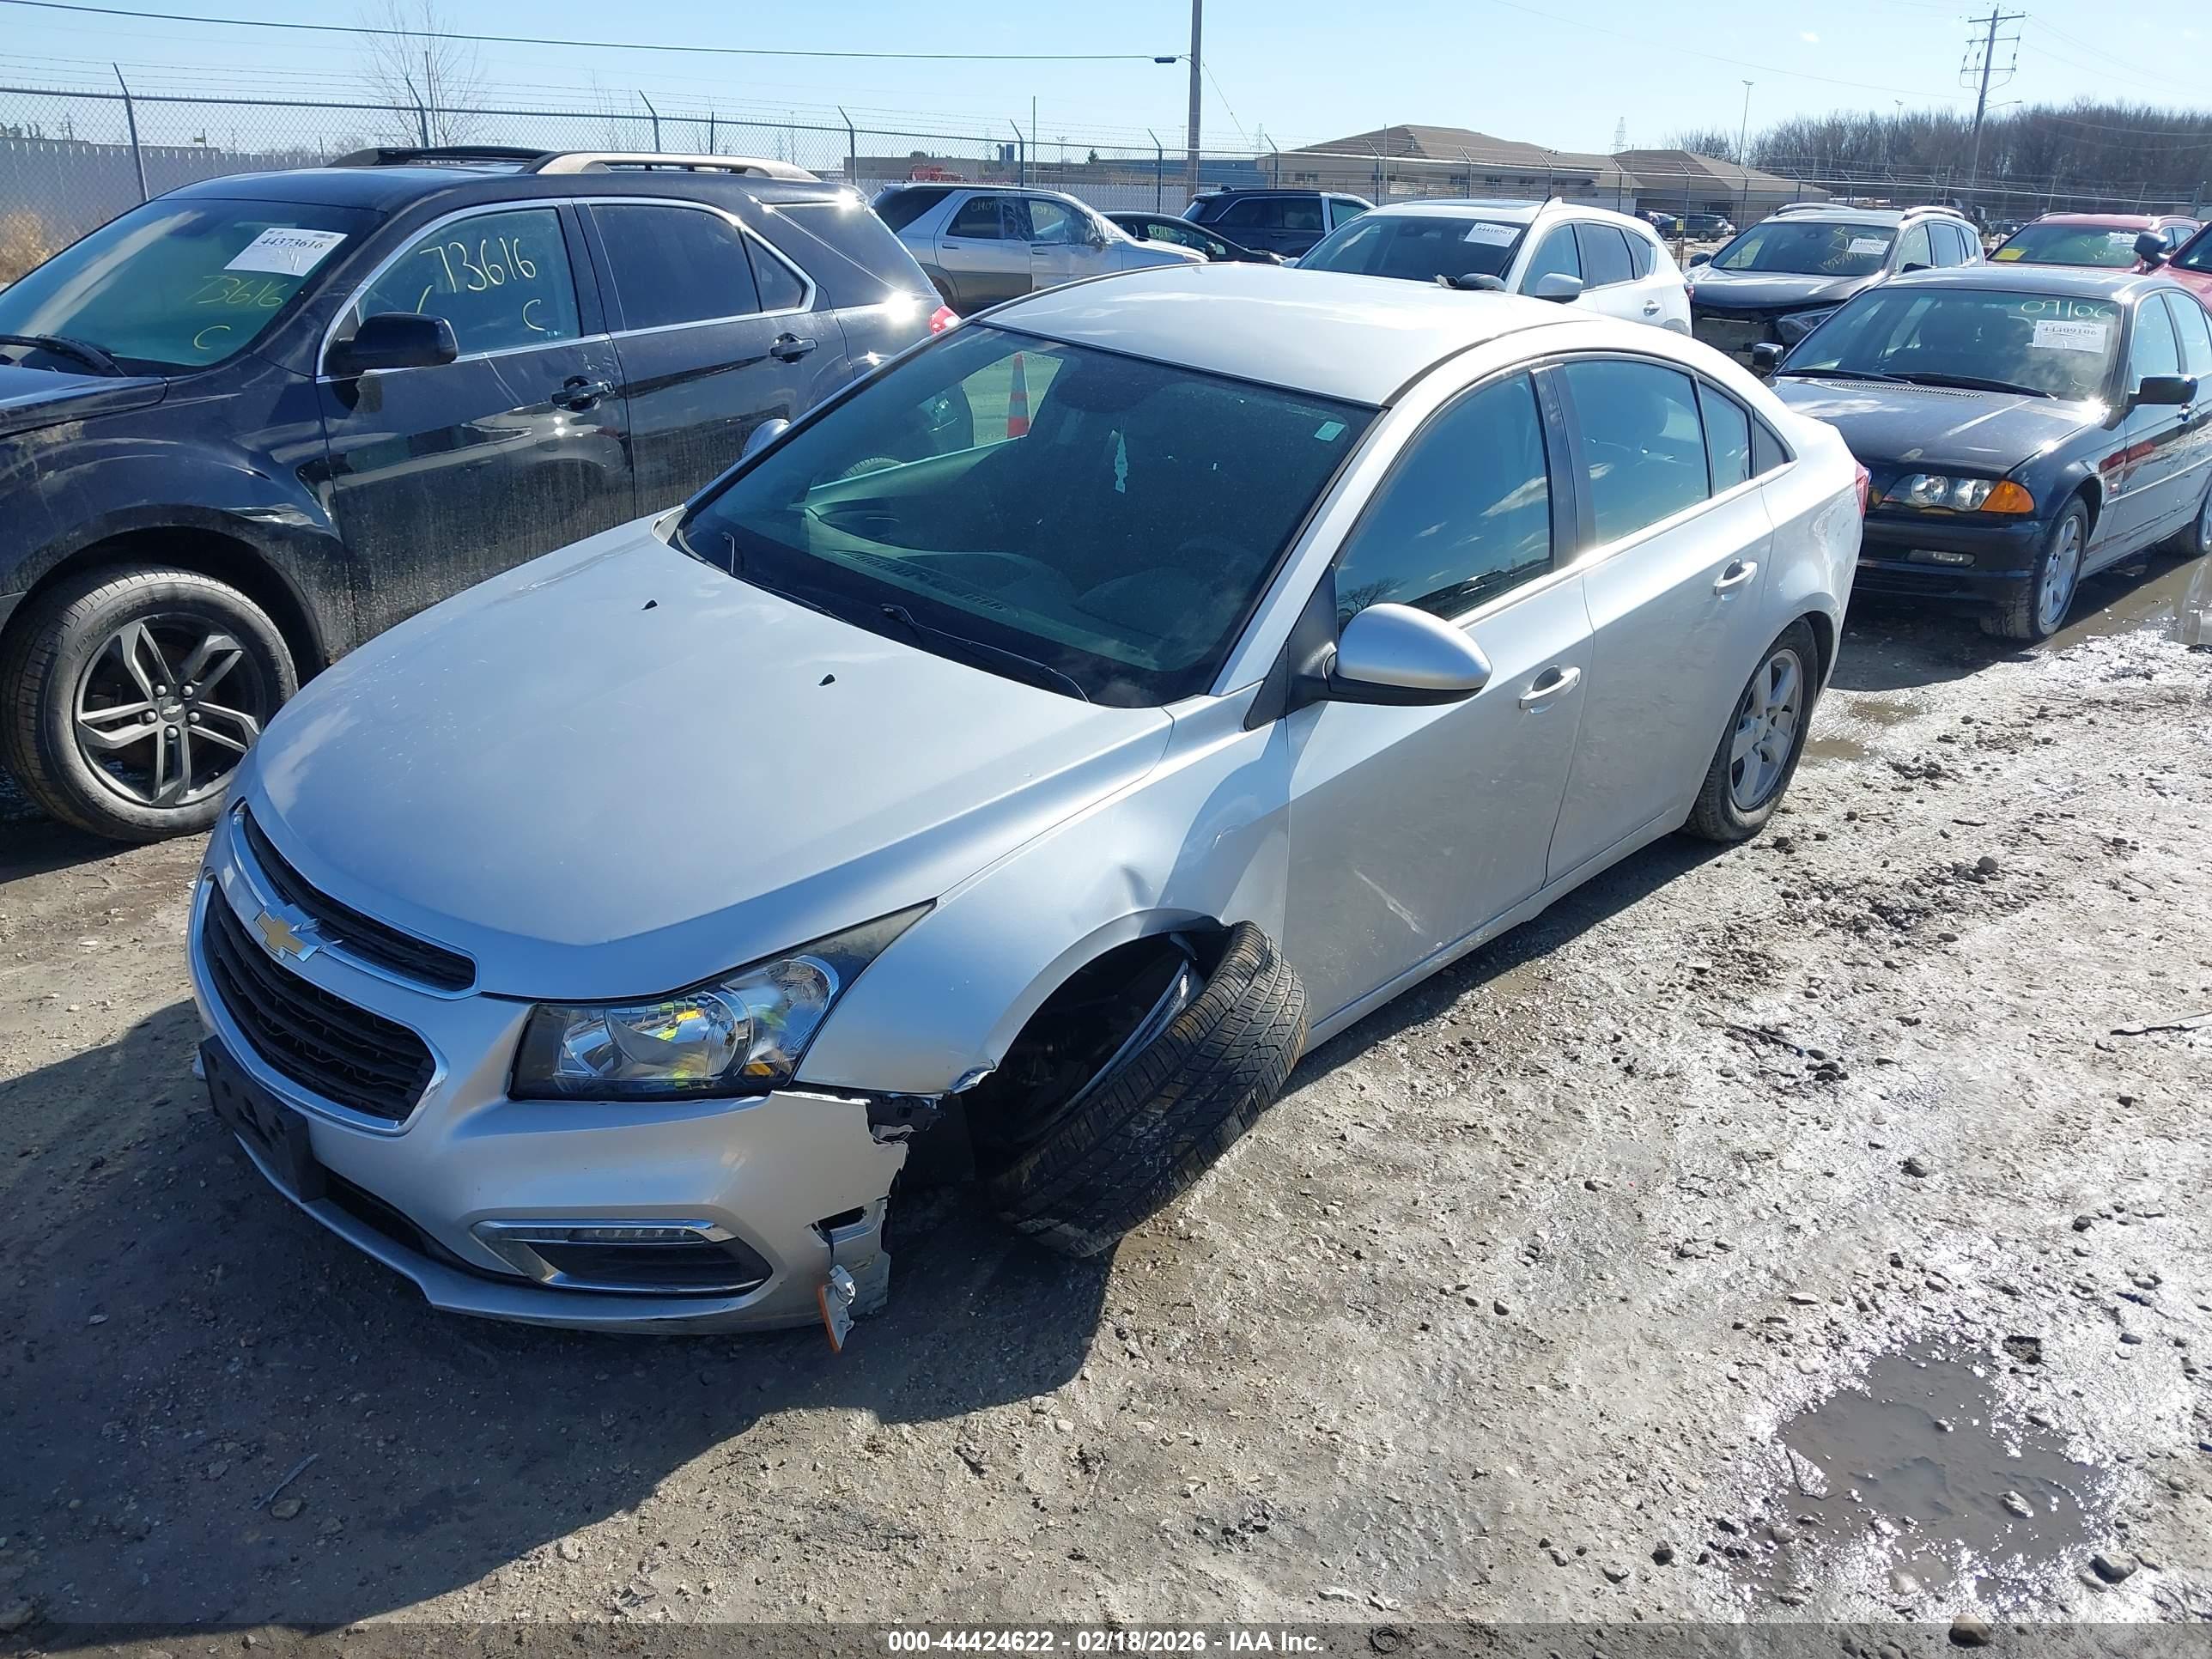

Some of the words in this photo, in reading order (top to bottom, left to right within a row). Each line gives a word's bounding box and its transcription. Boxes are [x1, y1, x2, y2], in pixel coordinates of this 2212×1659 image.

[260, 236, 325, 250] 44373616
[419, 236, 536, 293] 73616
[185, 275, 289, 307] 73616
[2021, 299, 2112, 319] 09106
